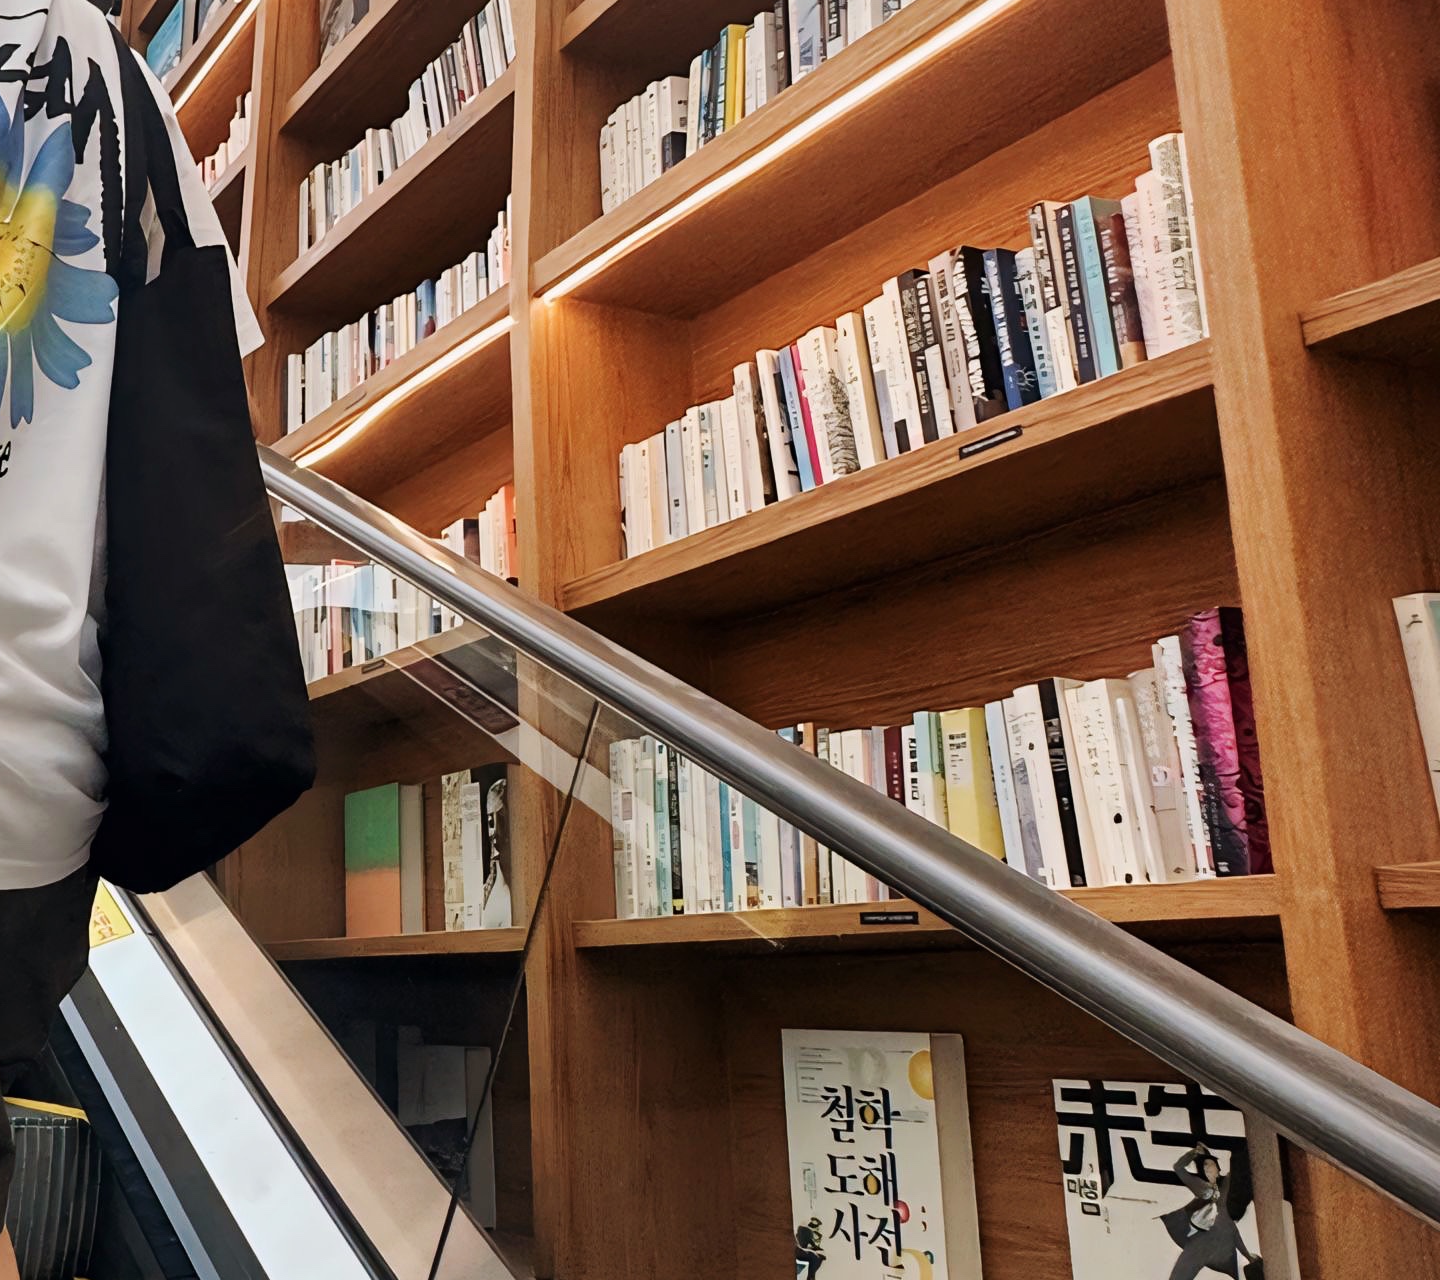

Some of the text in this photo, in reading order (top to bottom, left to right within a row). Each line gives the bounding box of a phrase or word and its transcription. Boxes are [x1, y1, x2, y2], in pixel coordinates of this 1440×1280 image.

[820, 1085, 902, 1150] 철학
[824, 1151, 901, 1207] 도해
[828, 1202, 905, 1271] 사전
